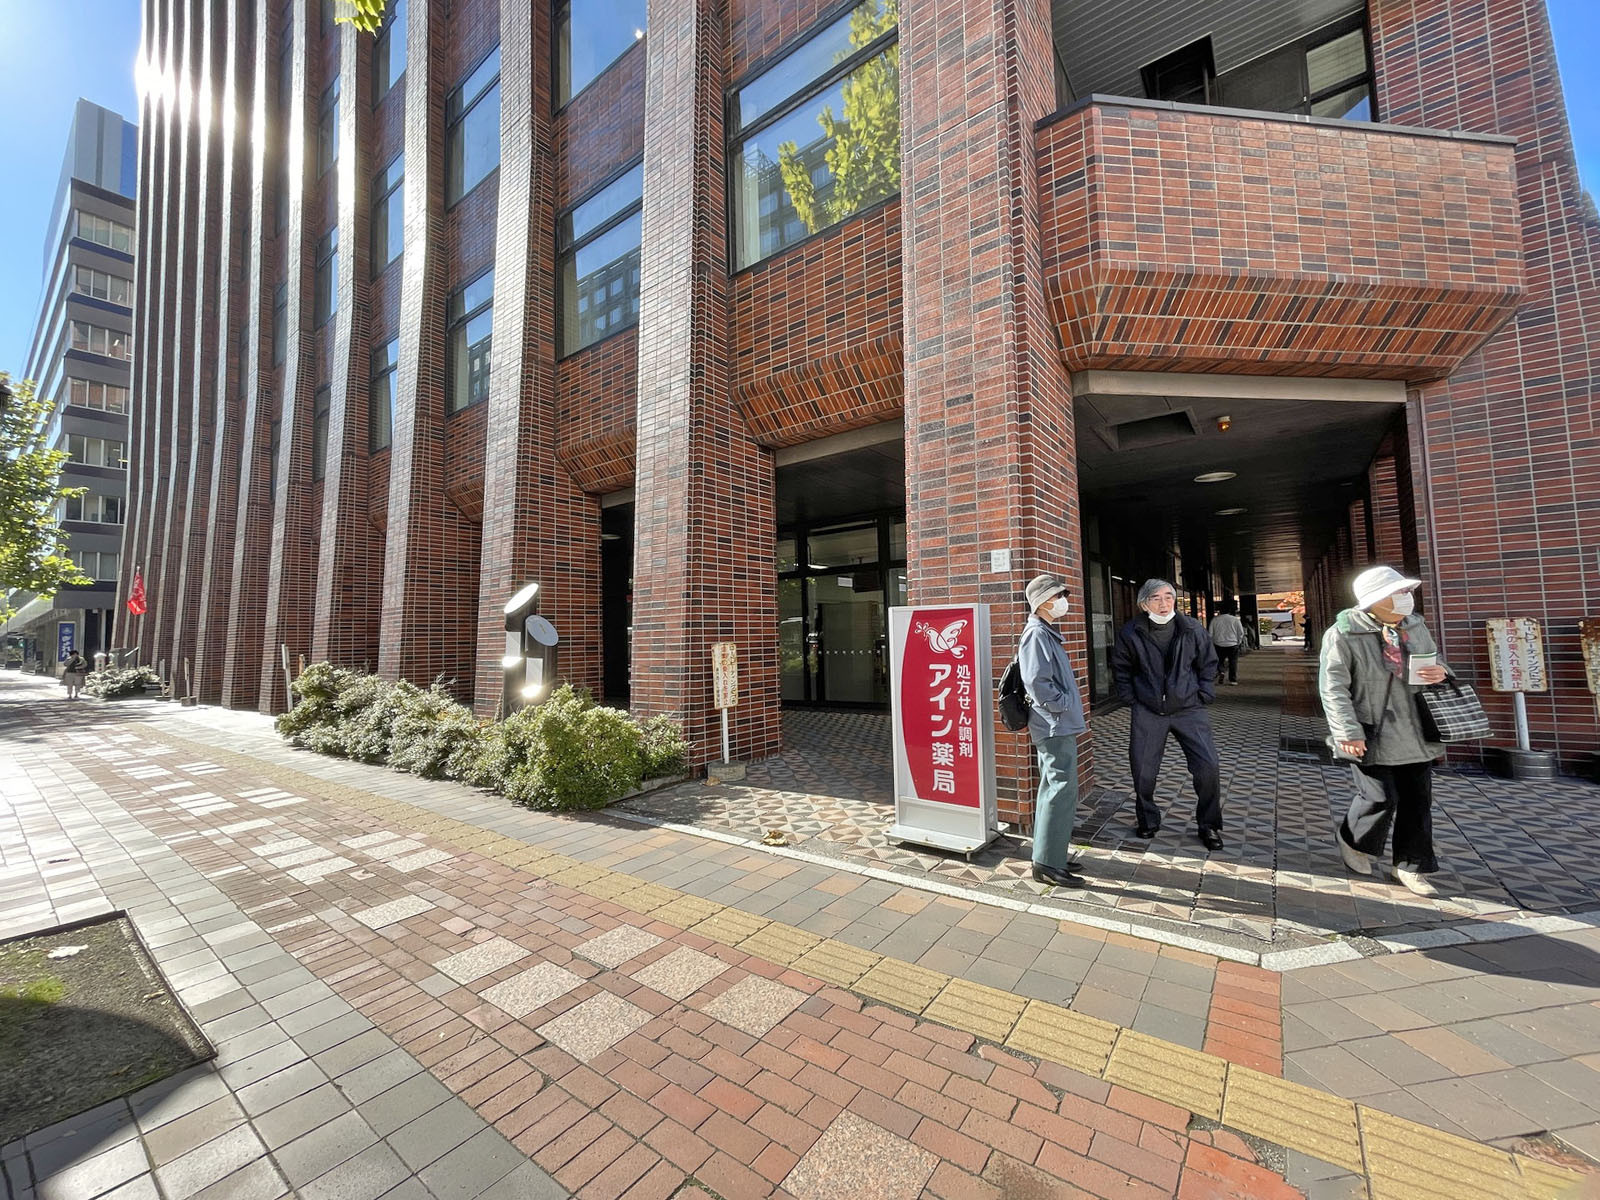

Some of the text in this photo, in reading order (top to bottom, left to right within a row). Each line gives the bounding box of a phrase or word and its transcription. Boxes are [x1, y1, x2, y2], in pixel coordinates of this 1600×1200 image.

[928, 663, 955, 795] アイン薬局
[956, 664, 973, 758] 処方せん調剤
